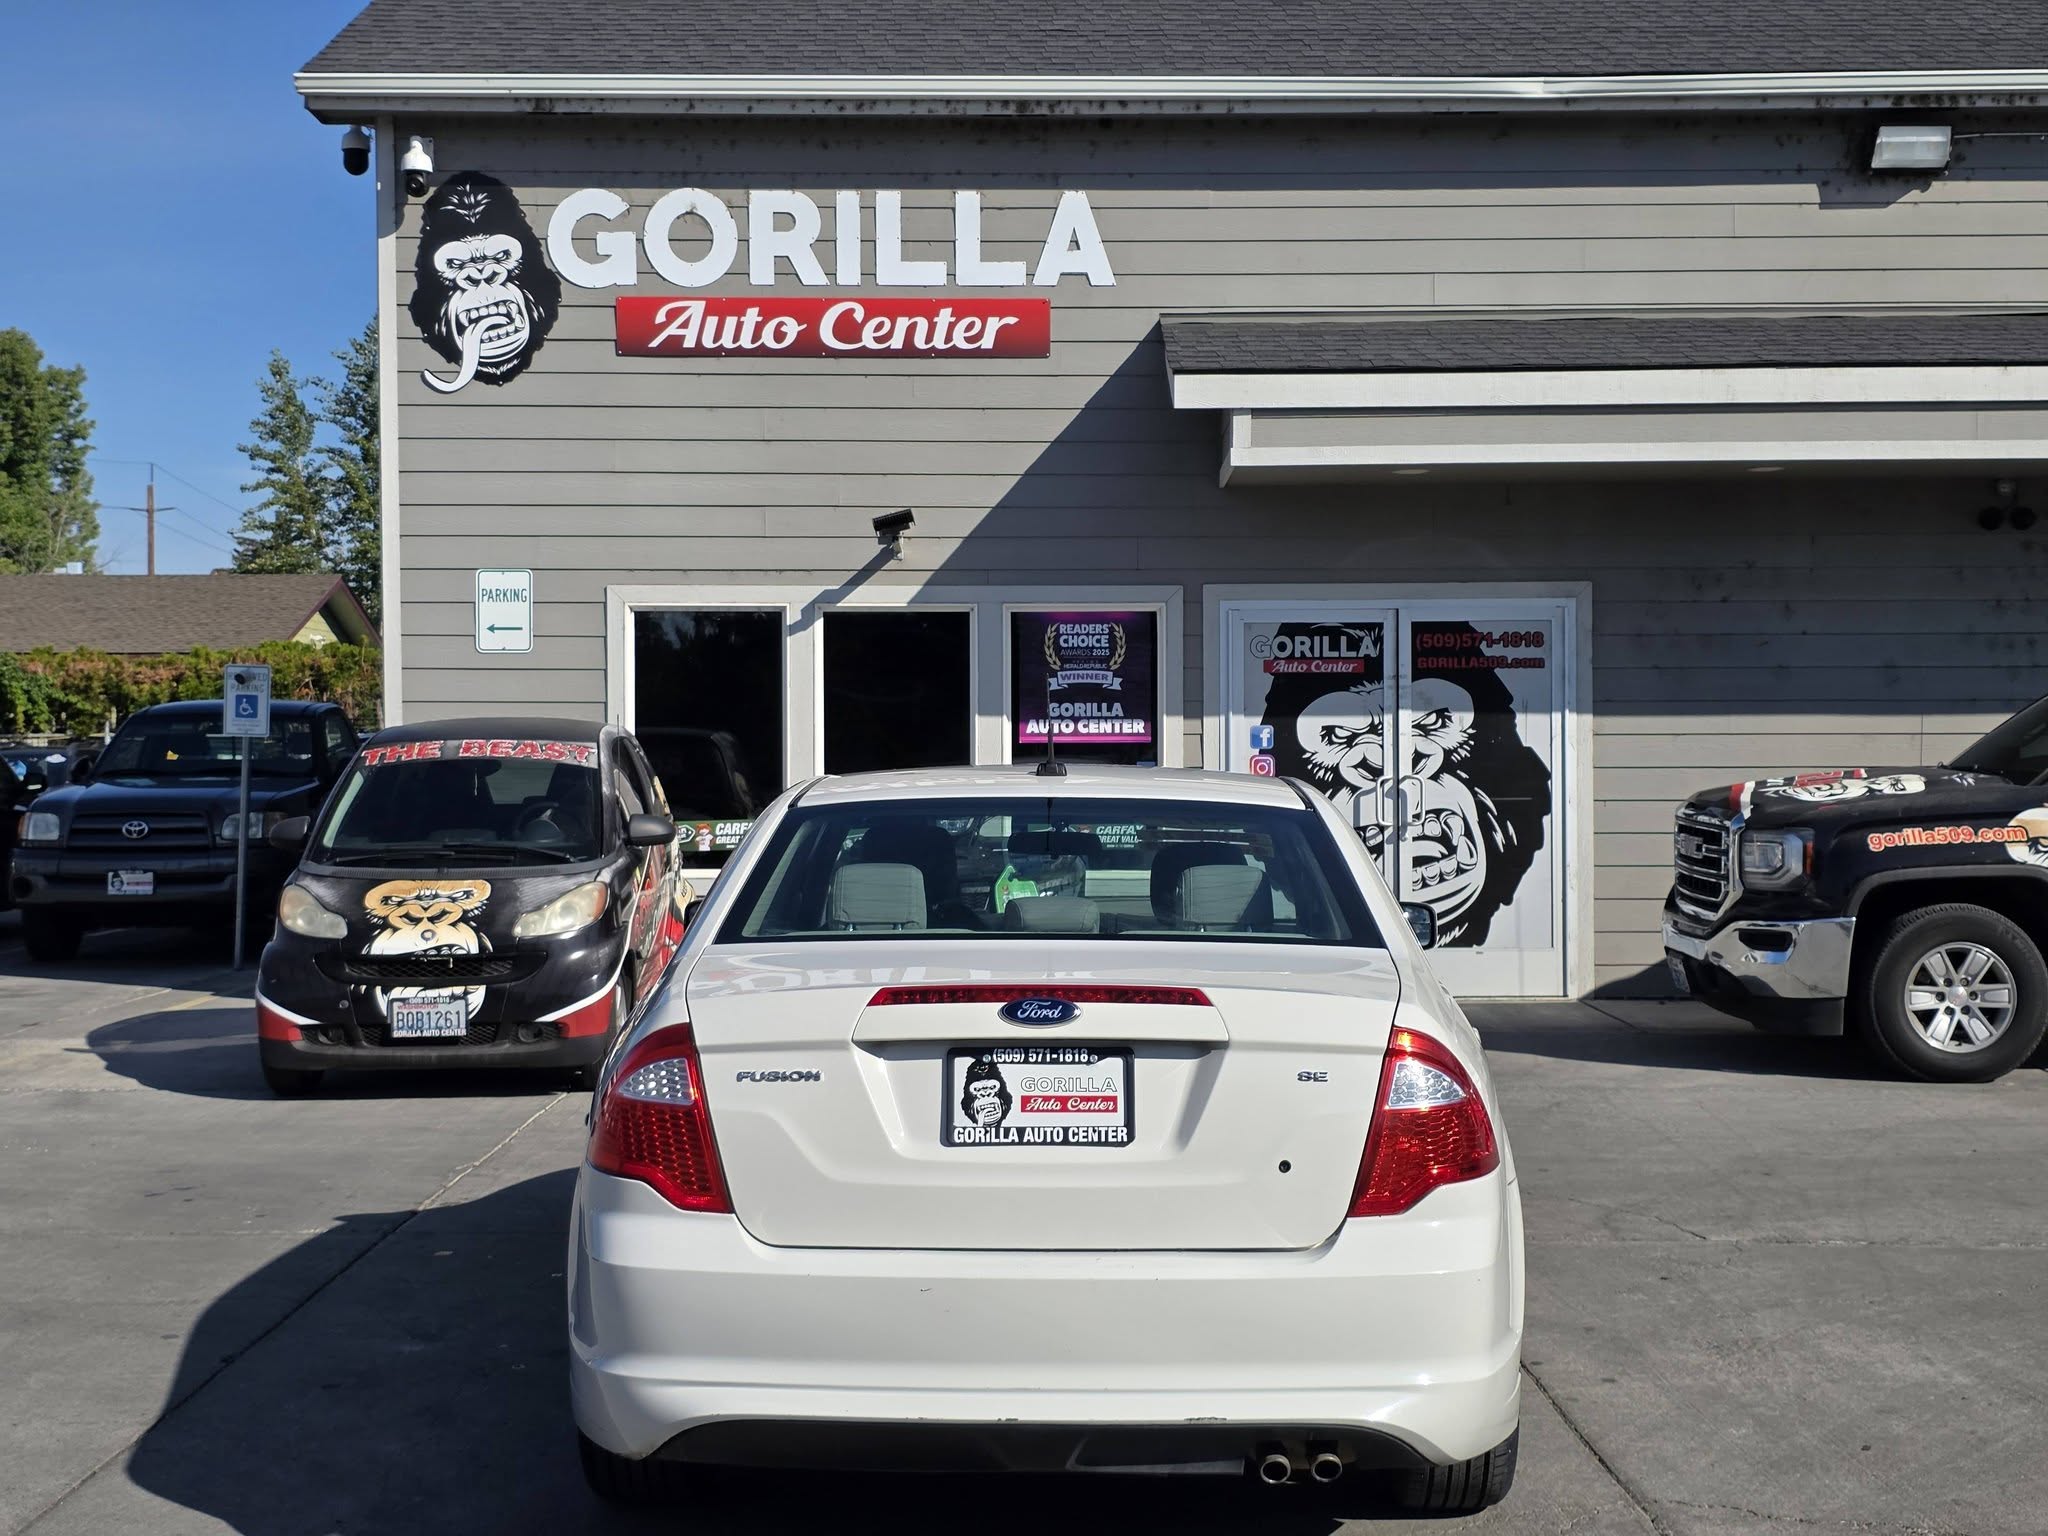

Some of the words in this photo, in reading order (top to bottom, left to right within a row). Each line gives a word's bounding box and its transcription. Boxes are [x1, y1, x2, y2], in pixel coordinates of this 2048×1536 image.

[547, 188, 1116, 288] GORILLA
[647, 300, 806, 349] Auto
[820, 301, 1019, 350] Center
[481, 588, 527, 603] PARKING
[1060, 635, 1109, 648] CHOICE
[1250, 635, 1377, 658] GORILLA
[1272, 660, 1308, 673] Auto
[1311, 660, 1357, 673] Center
[1417, 656, 1545, 669] GORILLA509.com
[1060, 672, 1109, 681] WINNER
[1049, 703, 1124, 717] GORILLA
[1026, 719, 1074, 733] AUTO
[1077, 719, 1145, 733] CENTER
[361, 740, 444, 766] THE
[459, 739, 598, 764] BEAST
[716, 823, 753, 835] CARF
[716, 836, 740, 844] GREAT
[1868, 826, 2027, 851] gorilla509.com
[1017, 999, 1062, 1020] Ford
[441, 1028, 466, 1036] CENTER
[992, 1048, 1024, 1063] (509)
[1028, 1048, 1088, 1063] 571-1818
[736, 1070, 821, 1083] FUSION
[1297, 1071, 1328, 1082] SE
[1021, 1077, 1118, 1092] GORILLA
[1025, 1097, 1062, 1111] Auto
[1067, 1097, 1116, 1111] Center
[953, 1127, 1019, 1143] GORILLA
[1023, 1127, 1064, 1142] AUTO
[1068, 1127, 1128, 1142] CENTER
